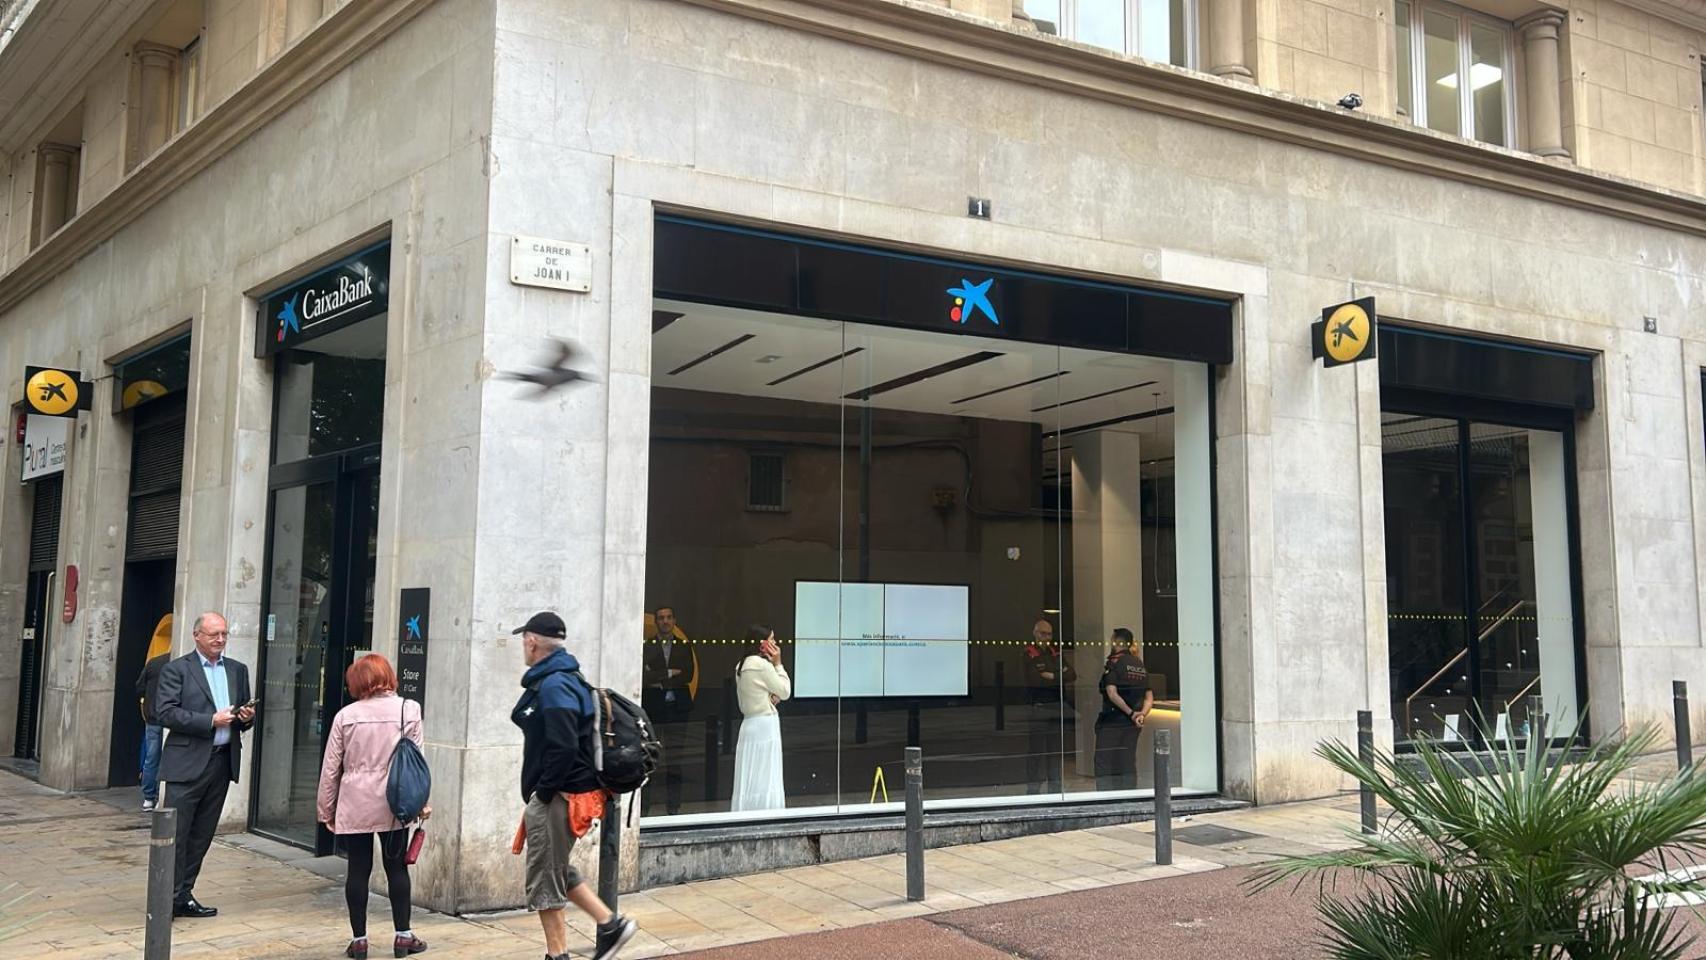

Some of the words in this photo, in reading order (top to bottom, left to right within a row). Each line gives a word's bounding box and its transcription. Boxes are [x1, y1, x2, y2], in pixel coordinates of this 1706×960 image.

[976, 200, 983, 216] 1
[533, 244, 572, 256] CARRER
[545, 257, 559, 266] DE
[534, 267, 562, 281] JOAN
[302, 265, 373, 320] CaixaBank
[402, 668, 420, 681] Store
